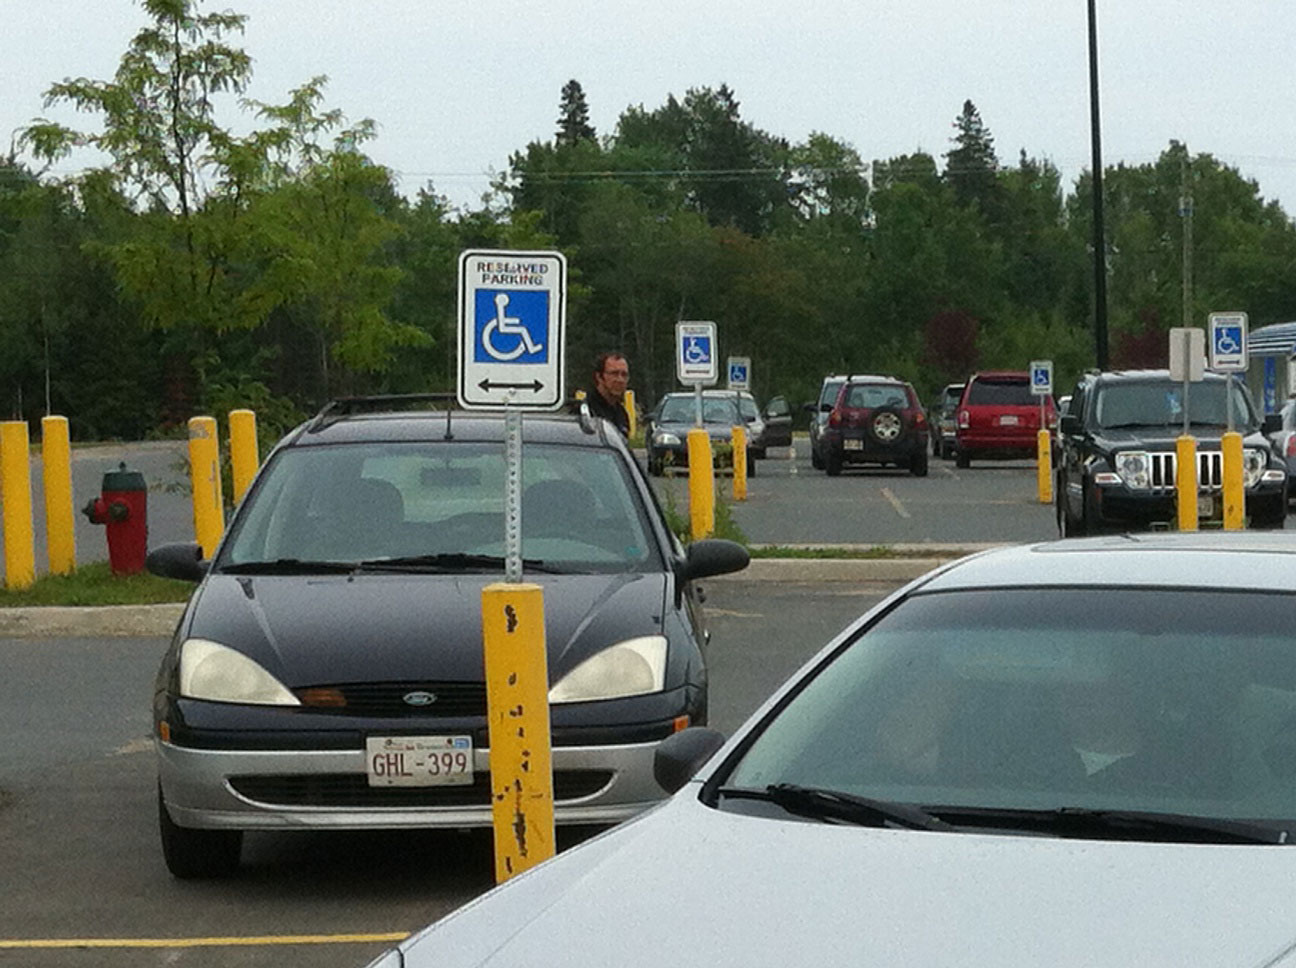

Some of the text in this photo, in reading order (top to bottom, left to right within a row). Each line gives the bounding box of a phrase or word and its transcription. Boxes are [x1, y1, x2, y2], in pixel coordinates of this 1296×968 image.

[477, 261, 549, 274] RESERVED
[481, 274, 544, 286] PARKING
[372, 752, 468, 777] GHL-399
